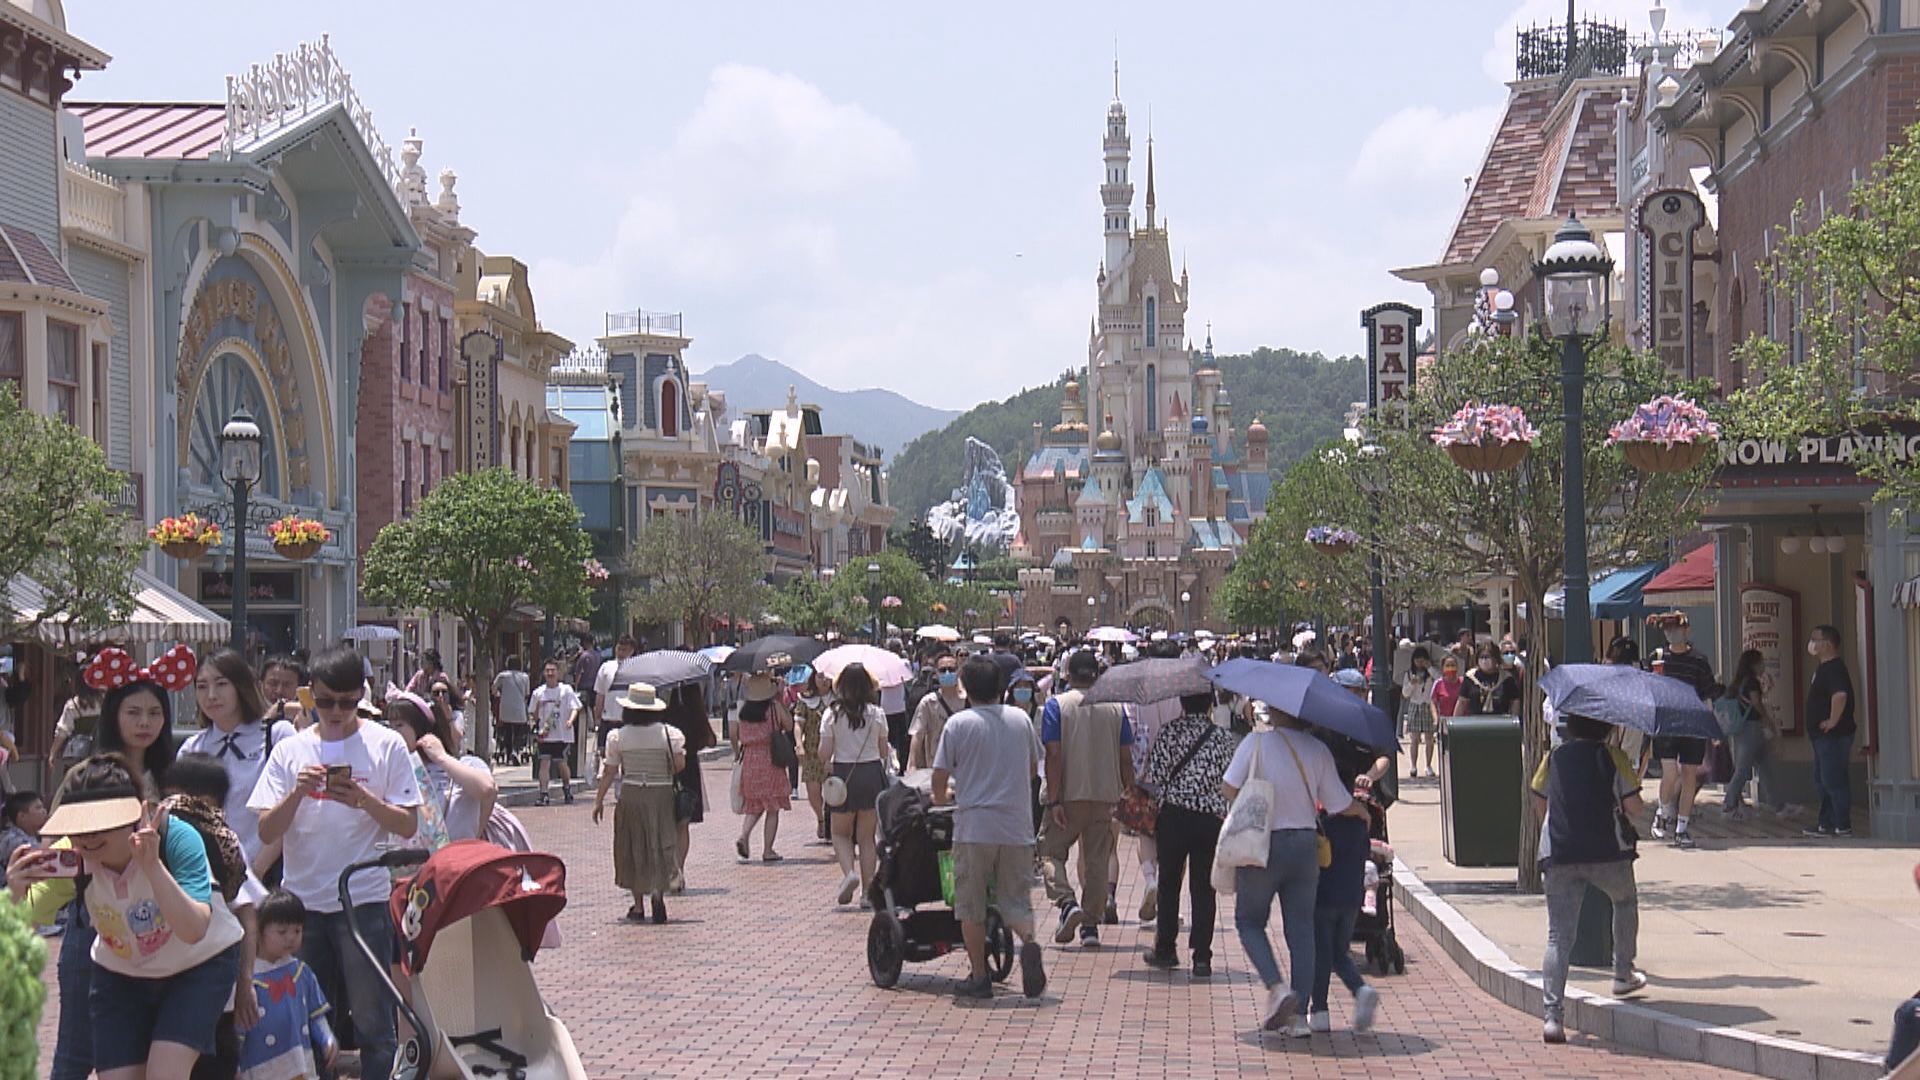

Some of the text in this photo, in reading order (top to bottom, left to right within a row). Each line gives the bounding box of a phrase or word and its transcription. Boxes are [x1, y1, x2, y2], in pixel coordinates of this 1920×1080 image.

[1658, 231, 1686, 370] CINEM
[1379, 324, 1407, 425] BAK
[1718, 438, 1787, 465] NOW
